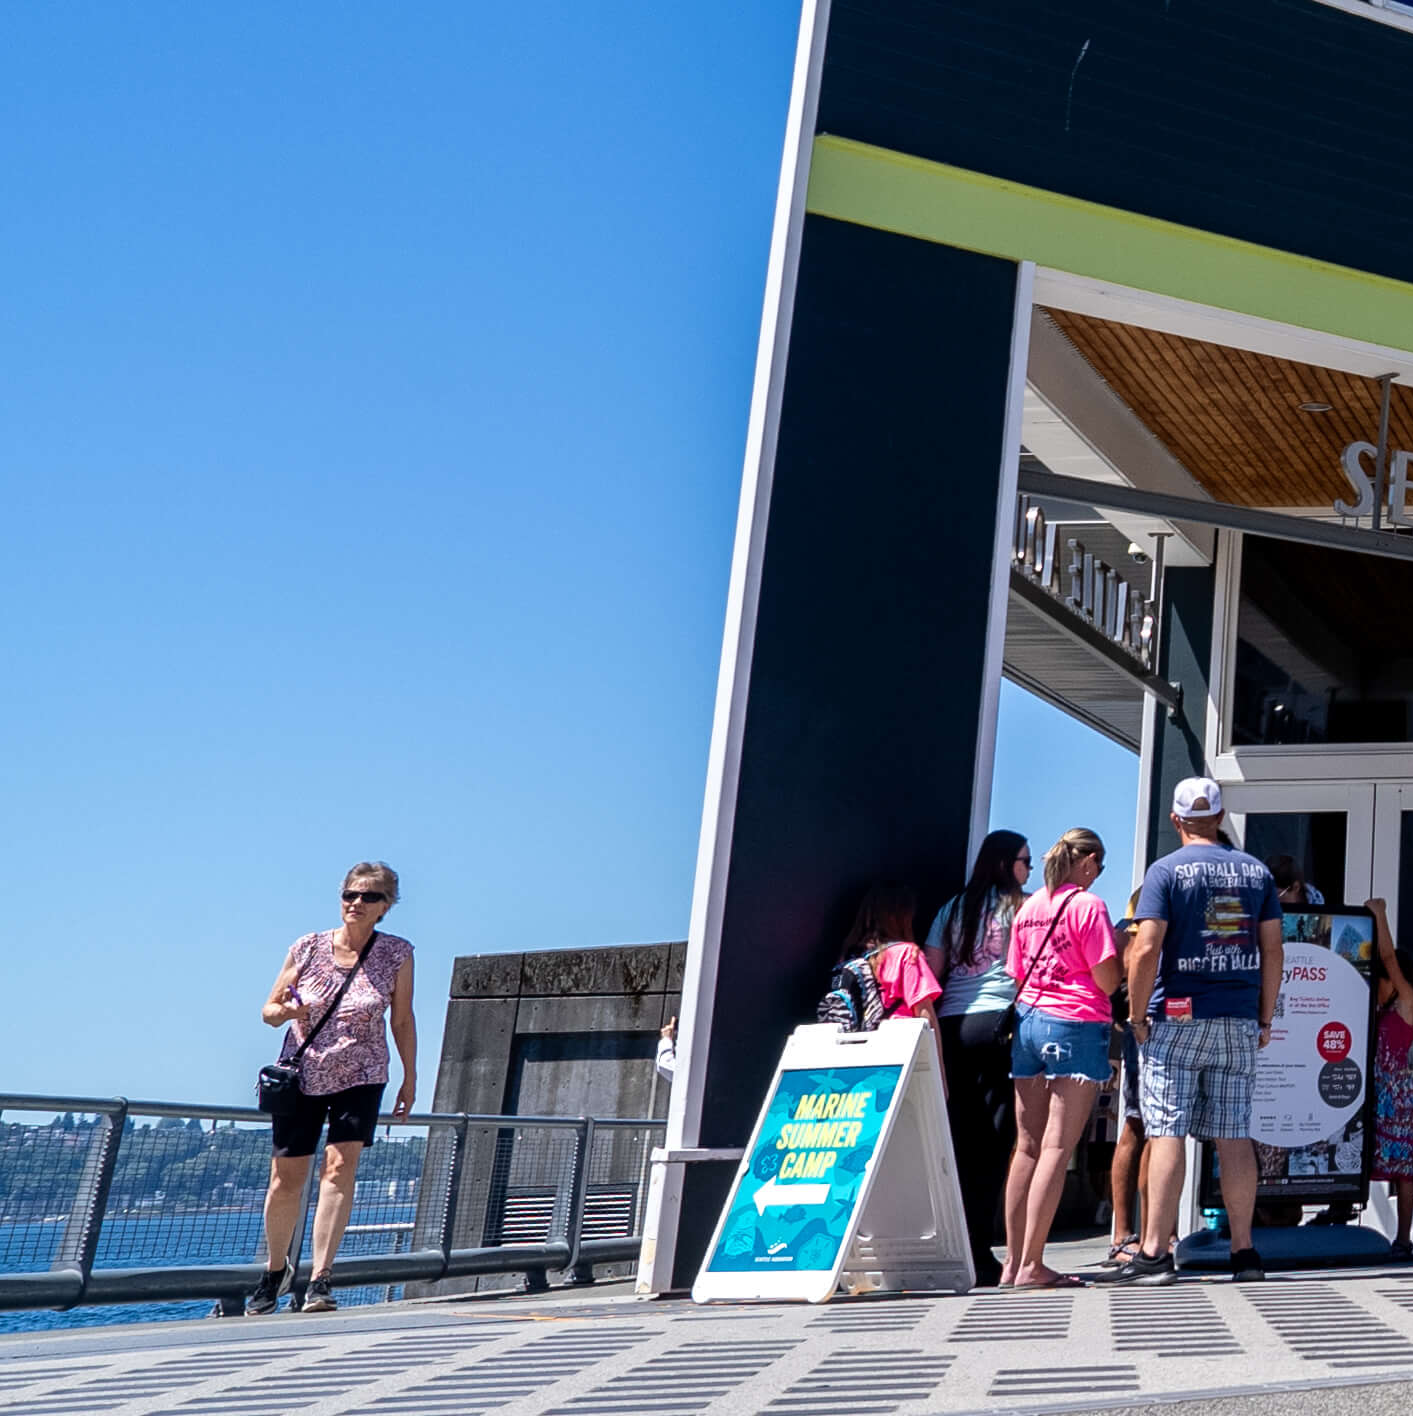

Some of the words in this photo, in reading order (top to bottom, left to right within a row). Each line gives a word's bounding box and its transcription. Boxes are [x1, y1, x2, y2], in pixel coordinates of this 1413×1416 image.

[1175, 862, 1239, 879] SOFTBALL
[1241, 863, 1264, 880] DAD
[1323, 1030, 1346, 1039] SAVE
[1323, 1039, 1346, 1050] 48%
[794, 1092, 872, 1120] MARINE
[776, 1121, 863, 1150] SUMMER
[779, 1151, 837, 1179] CAMP
